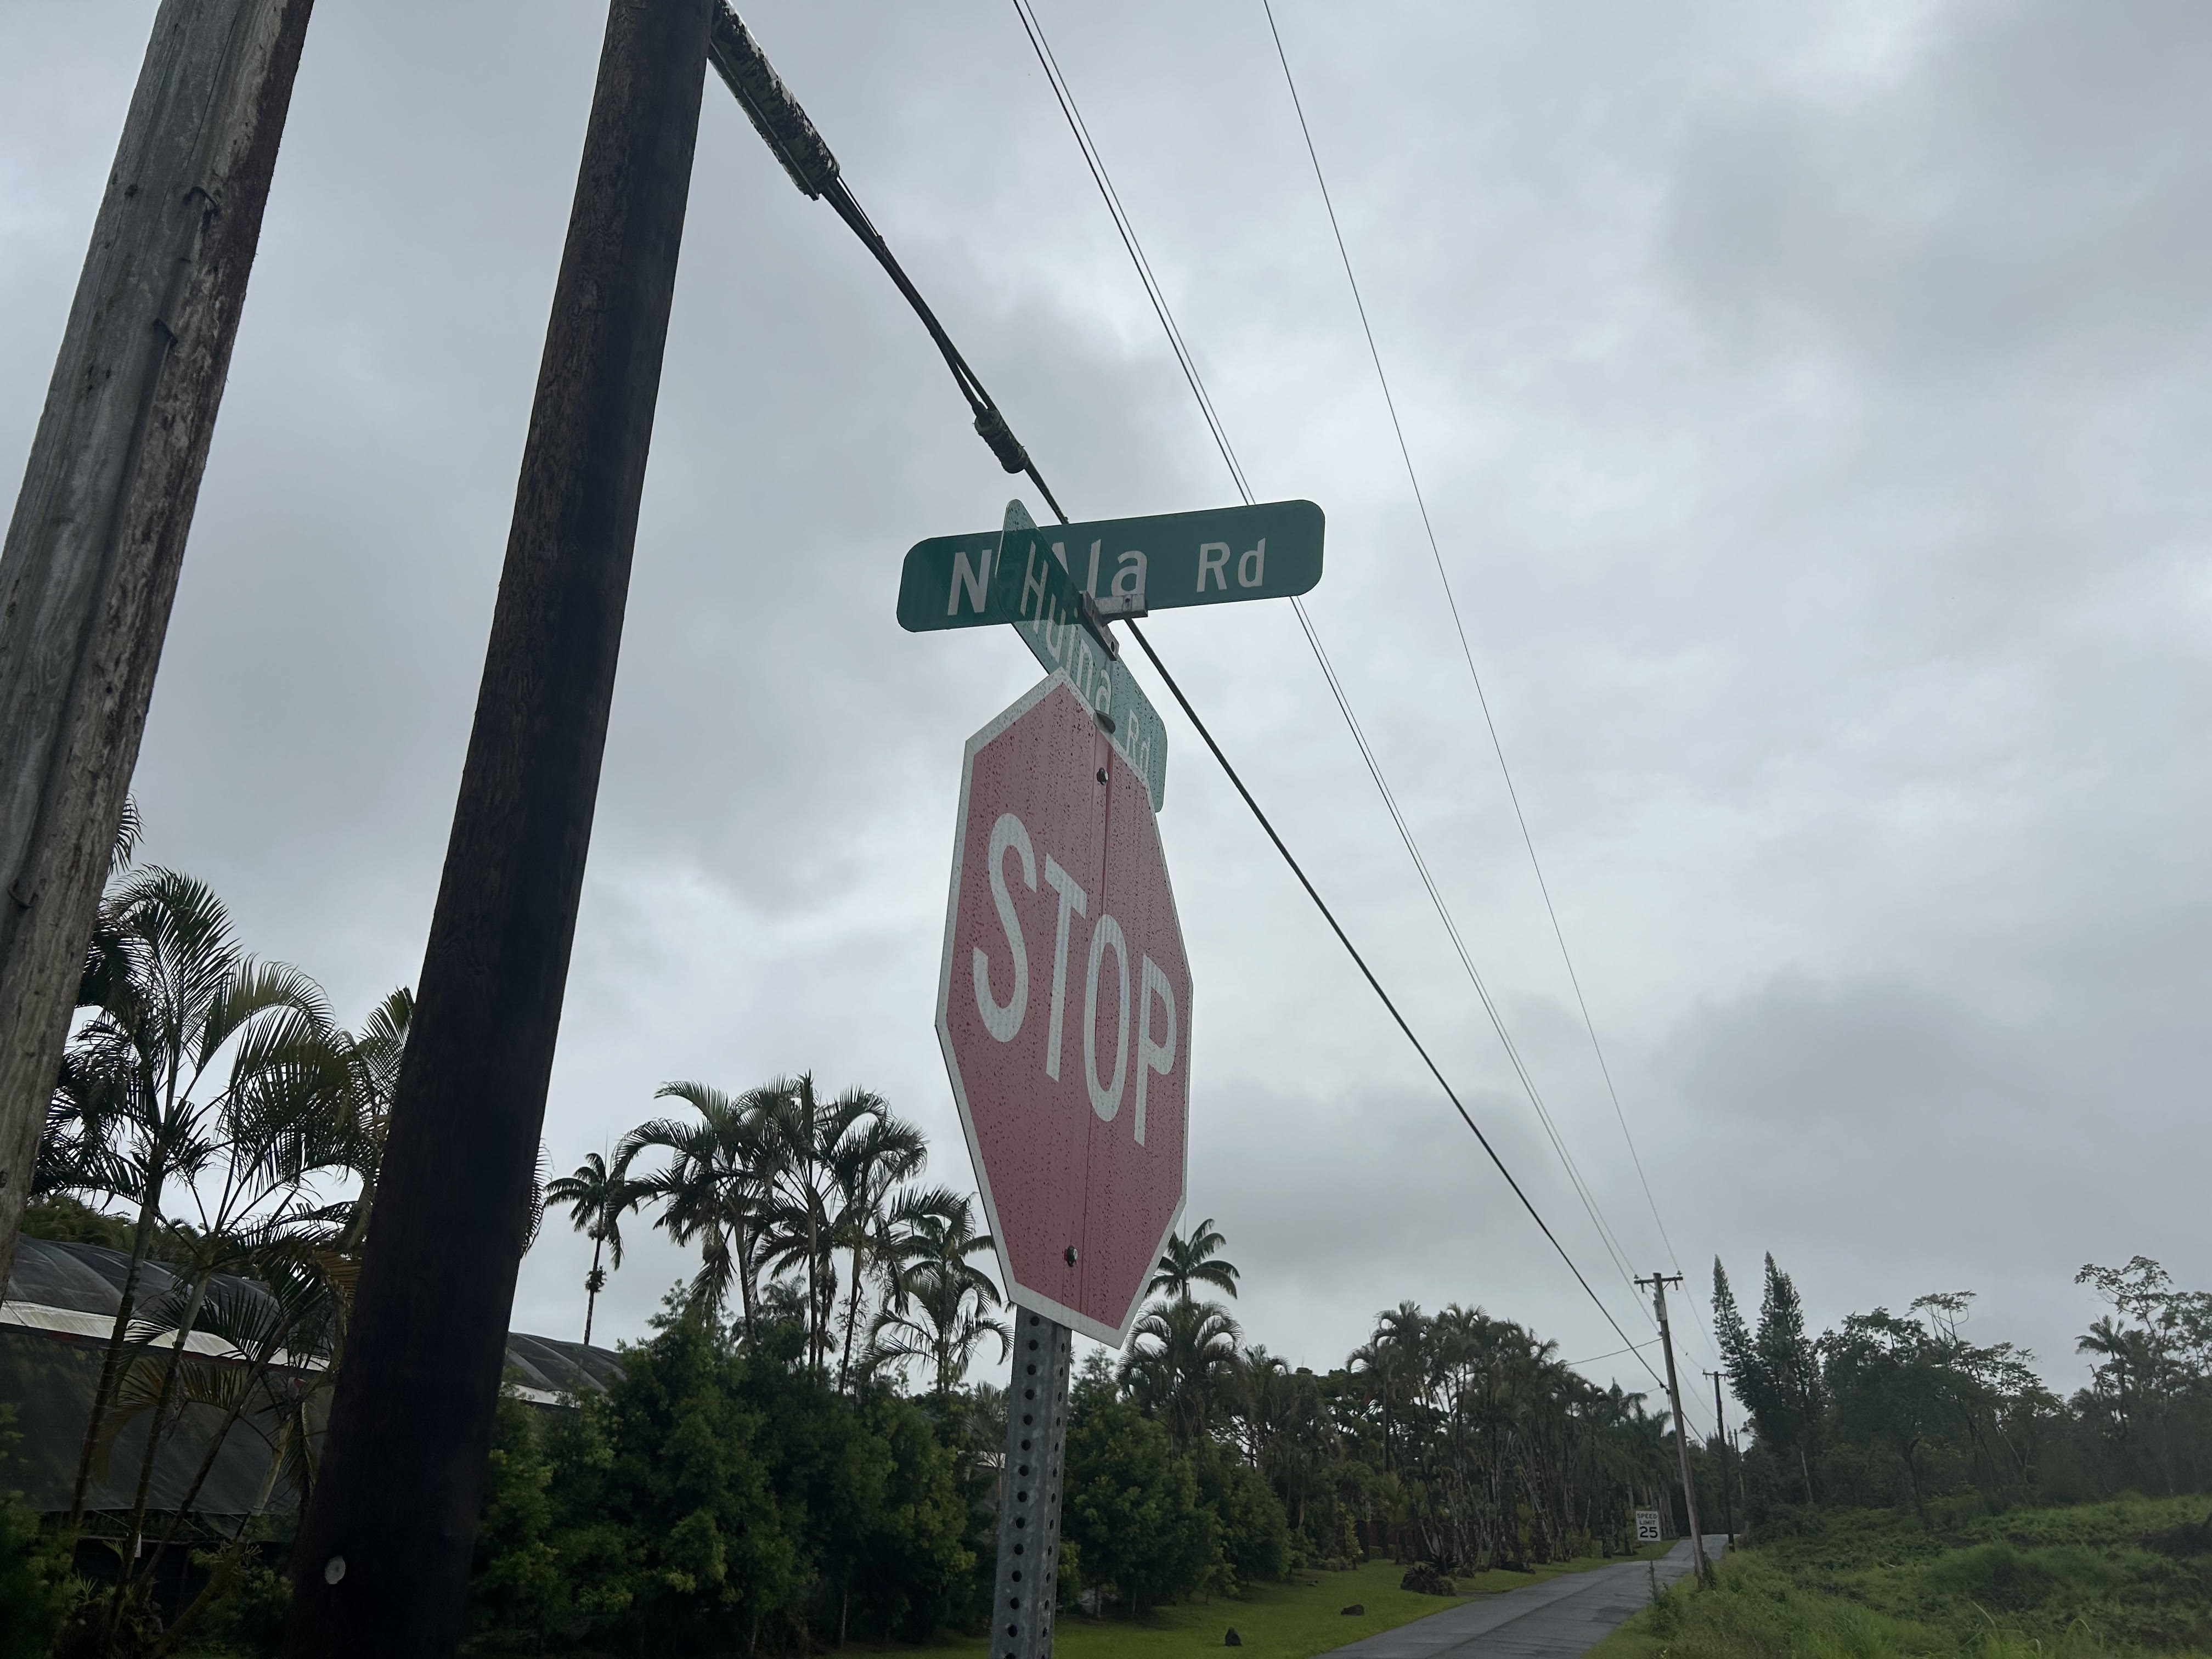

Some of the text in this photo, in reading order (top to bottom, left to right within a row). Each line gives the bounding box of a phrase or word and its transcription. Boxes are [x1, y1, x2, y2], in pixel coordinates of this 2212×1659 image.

[1052, 538, 1148, 599] la
[1197, 538, 1266, 593] Rd
[1020, 540, 1150, 773] Huina Rd
[973, 812, 1177, 1148] STOP
[1639, 1526, 1658, 1538] 25
